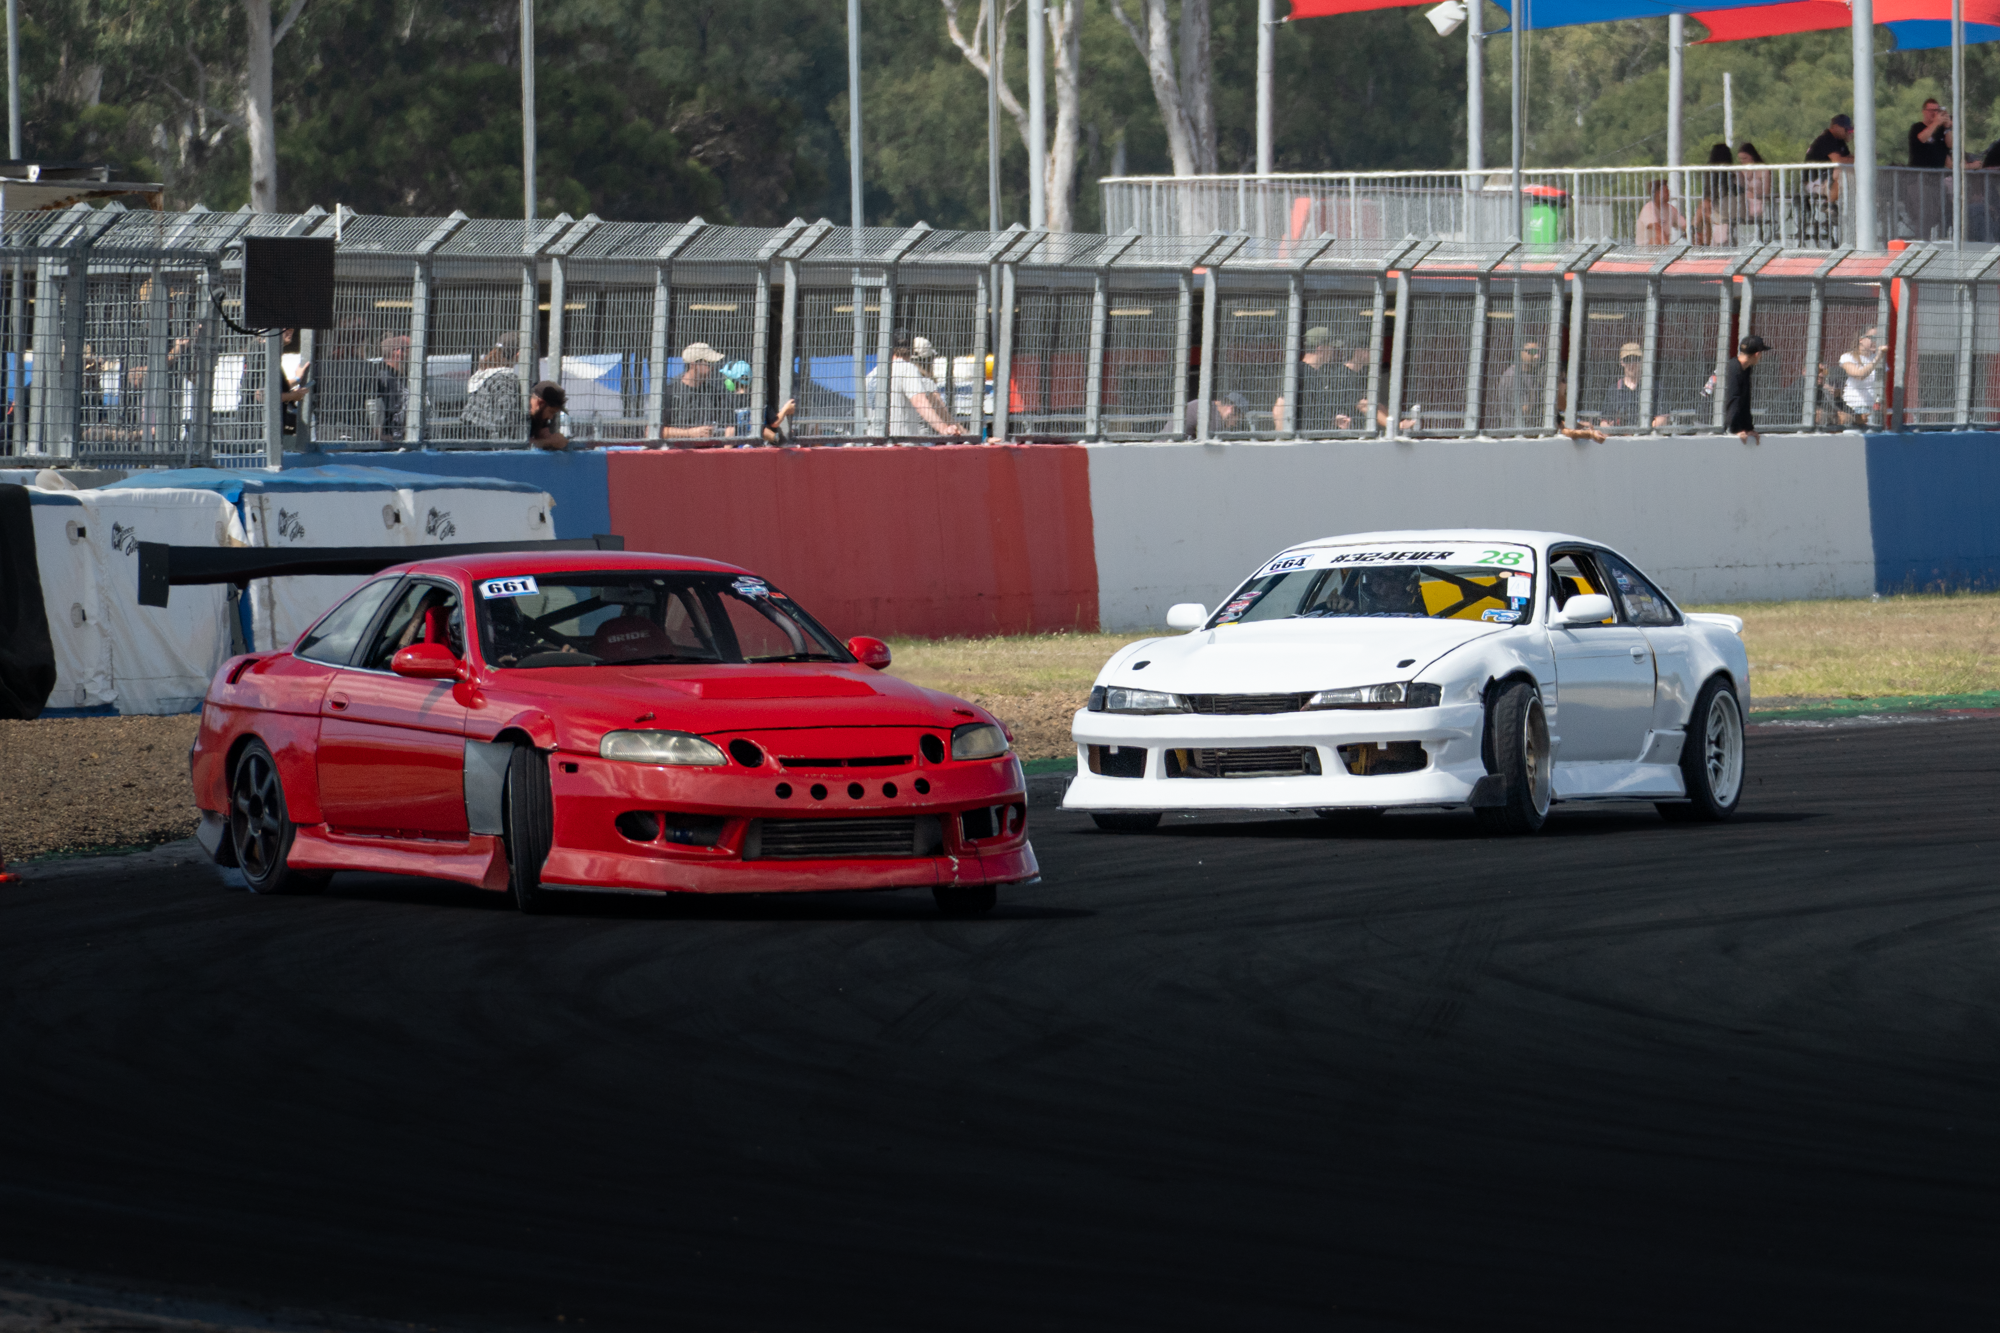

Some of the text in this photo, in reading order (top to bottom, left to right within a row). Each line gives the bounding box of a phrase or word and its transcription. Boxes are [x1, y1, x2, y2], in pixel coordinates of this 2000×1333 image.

[1269, 557, 1307, 571] 664
[1473, 550, 1524, 566] 28
[487, 580, 530, 594] 661
[607, 629, 650, 643] BRIDE
